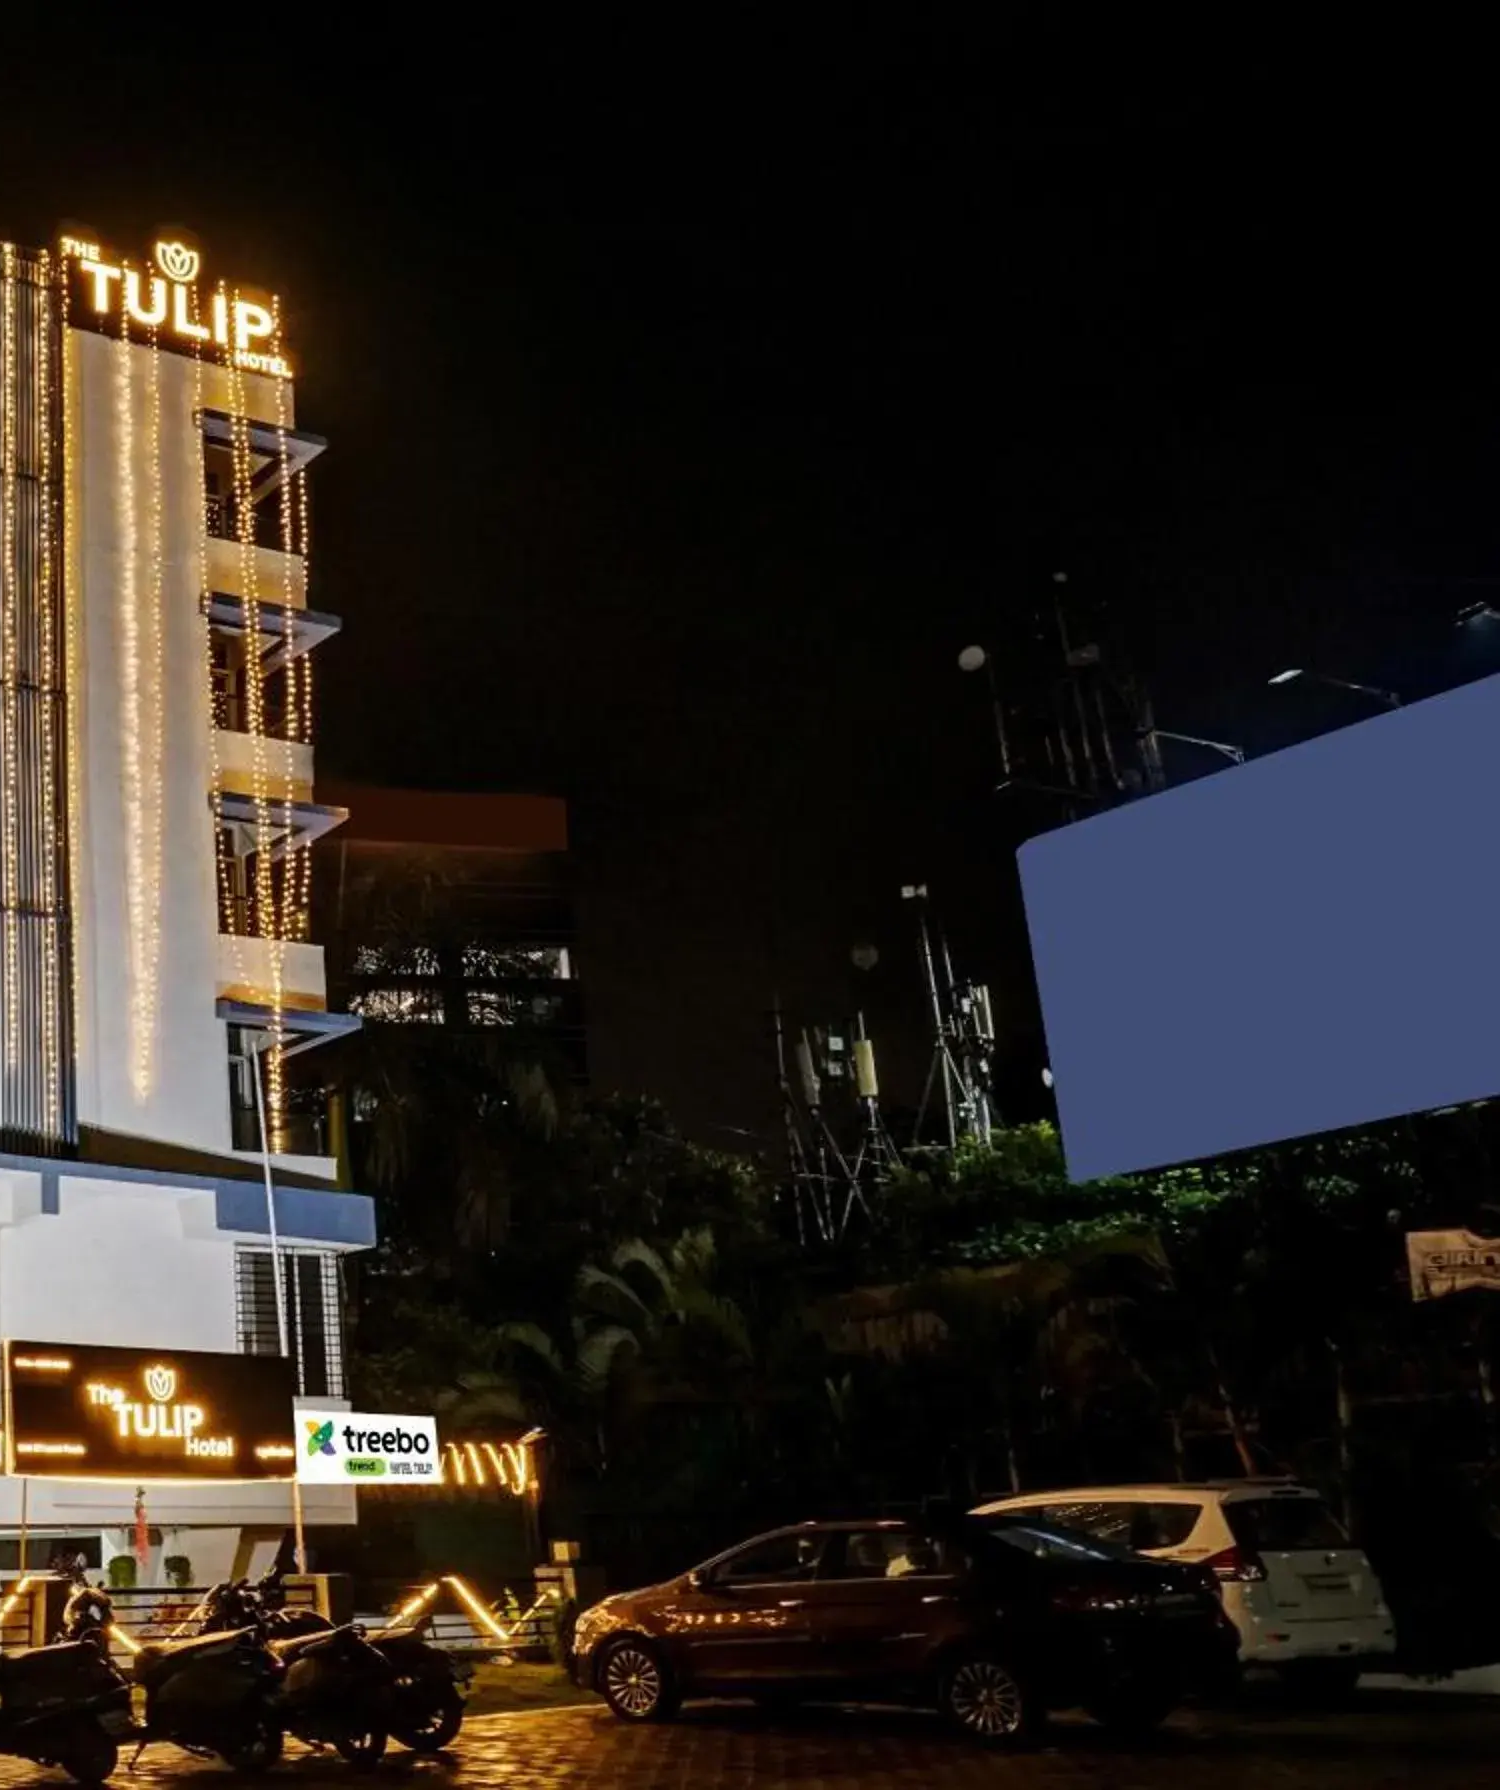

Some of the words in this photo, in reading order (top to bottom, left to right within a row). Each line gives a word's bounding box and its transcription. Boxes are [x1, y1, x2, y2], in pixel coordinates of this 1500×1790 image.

[61, 236, 100, 260] THE
[80, 259, 273, 349] TULIP
[234, 349, 293, 379] HOTEL
[87, 1382, 125, 1404] The
[113, 1402, 204, 1437] TULIP
[185, 1437, 234, 1457] Hotel
[342, 1425, 430, 1454] treebo
